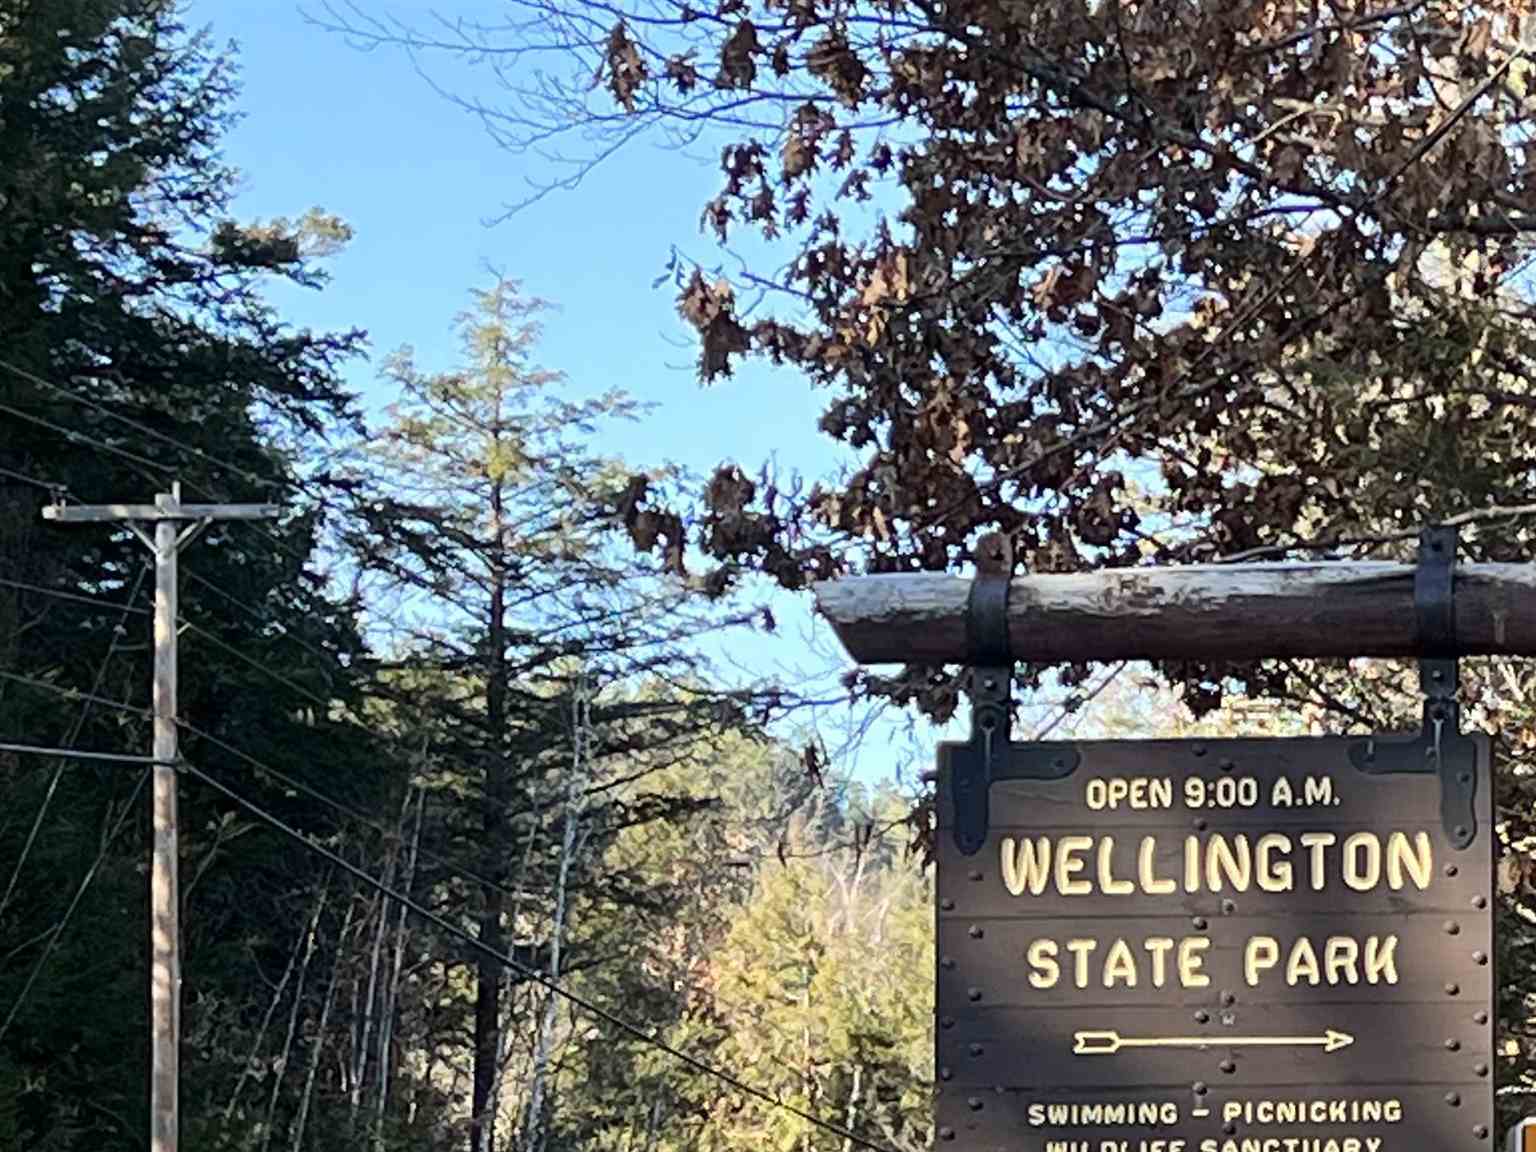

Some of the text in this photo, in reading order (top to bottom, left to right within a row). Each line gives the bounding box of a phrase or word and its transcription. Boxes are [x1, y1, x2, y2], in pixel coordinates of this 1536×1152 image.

[1086, 776, 1340, 810] OPEN 9:00 A.M.
[1001, 831, 1434, 896] WELLINGTON
[1027, 934, 1400, 989] STATE PARK
[1028, 1102, 1178, 1126] SWIMMING
[1223, 1099, 1402, 1124] PICNICKING
